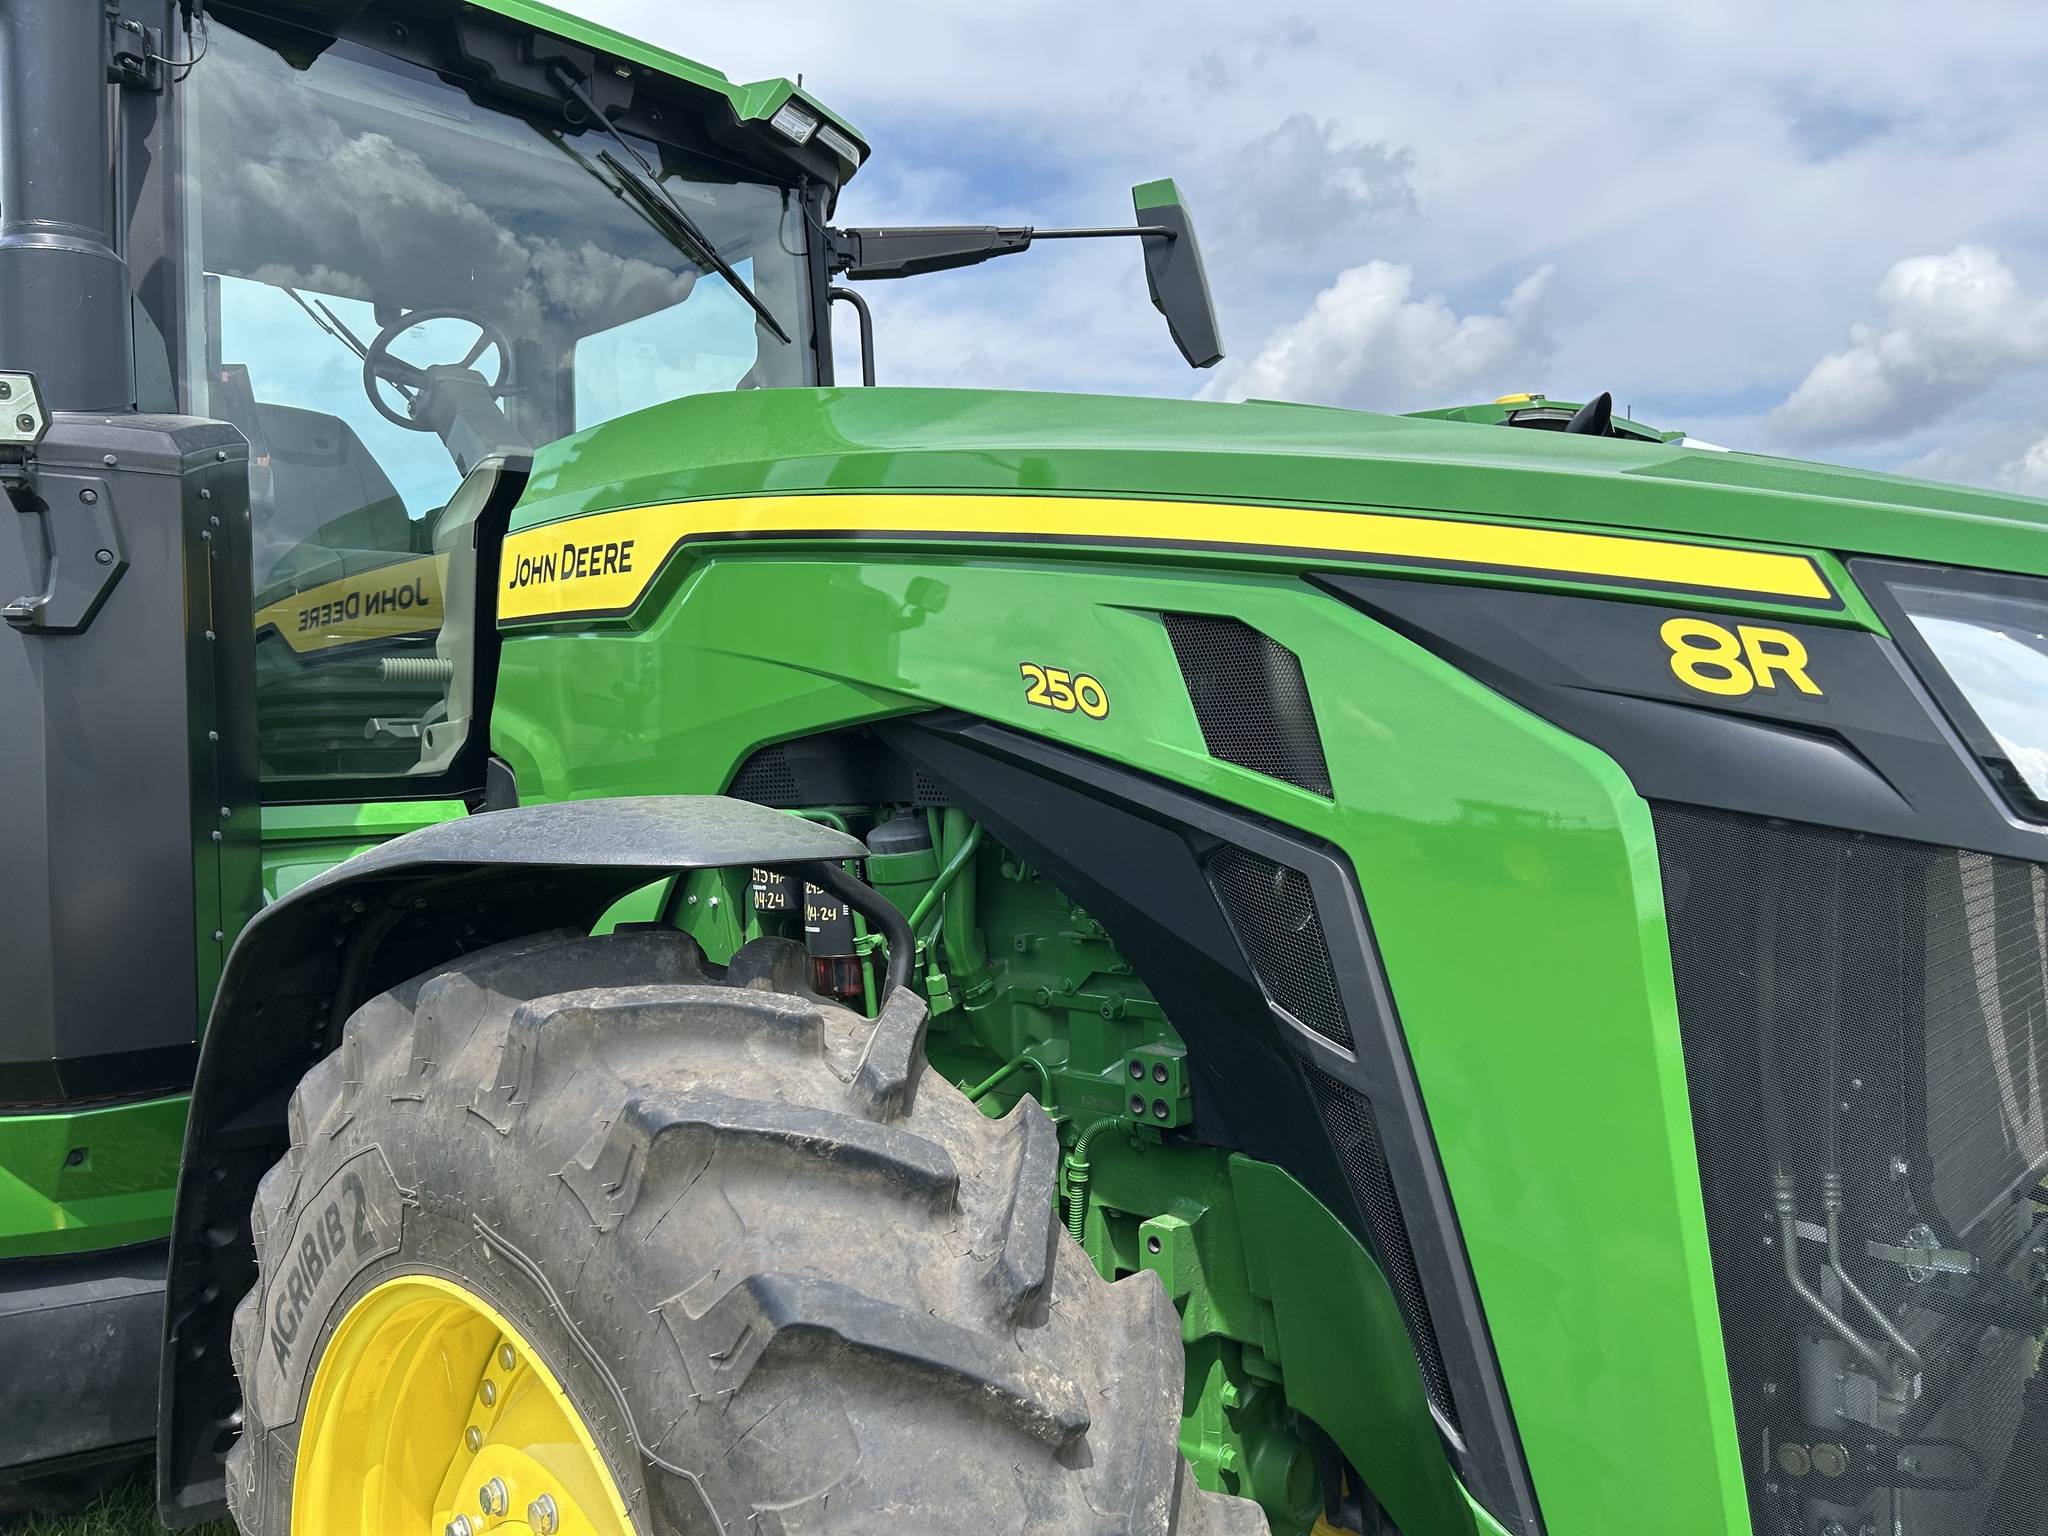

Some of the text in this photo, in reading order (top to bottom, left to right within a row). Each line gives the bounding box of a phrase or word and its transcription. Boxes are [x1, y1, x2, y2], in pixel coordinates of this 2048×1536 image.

[509, 540, 634, 589] JOHN DEERE
[1019, 661, 1110, 721] 250
[1660, 618, 1823, 696] 8R
[270, 1171, 378, 1380] AGRIBIB 2
